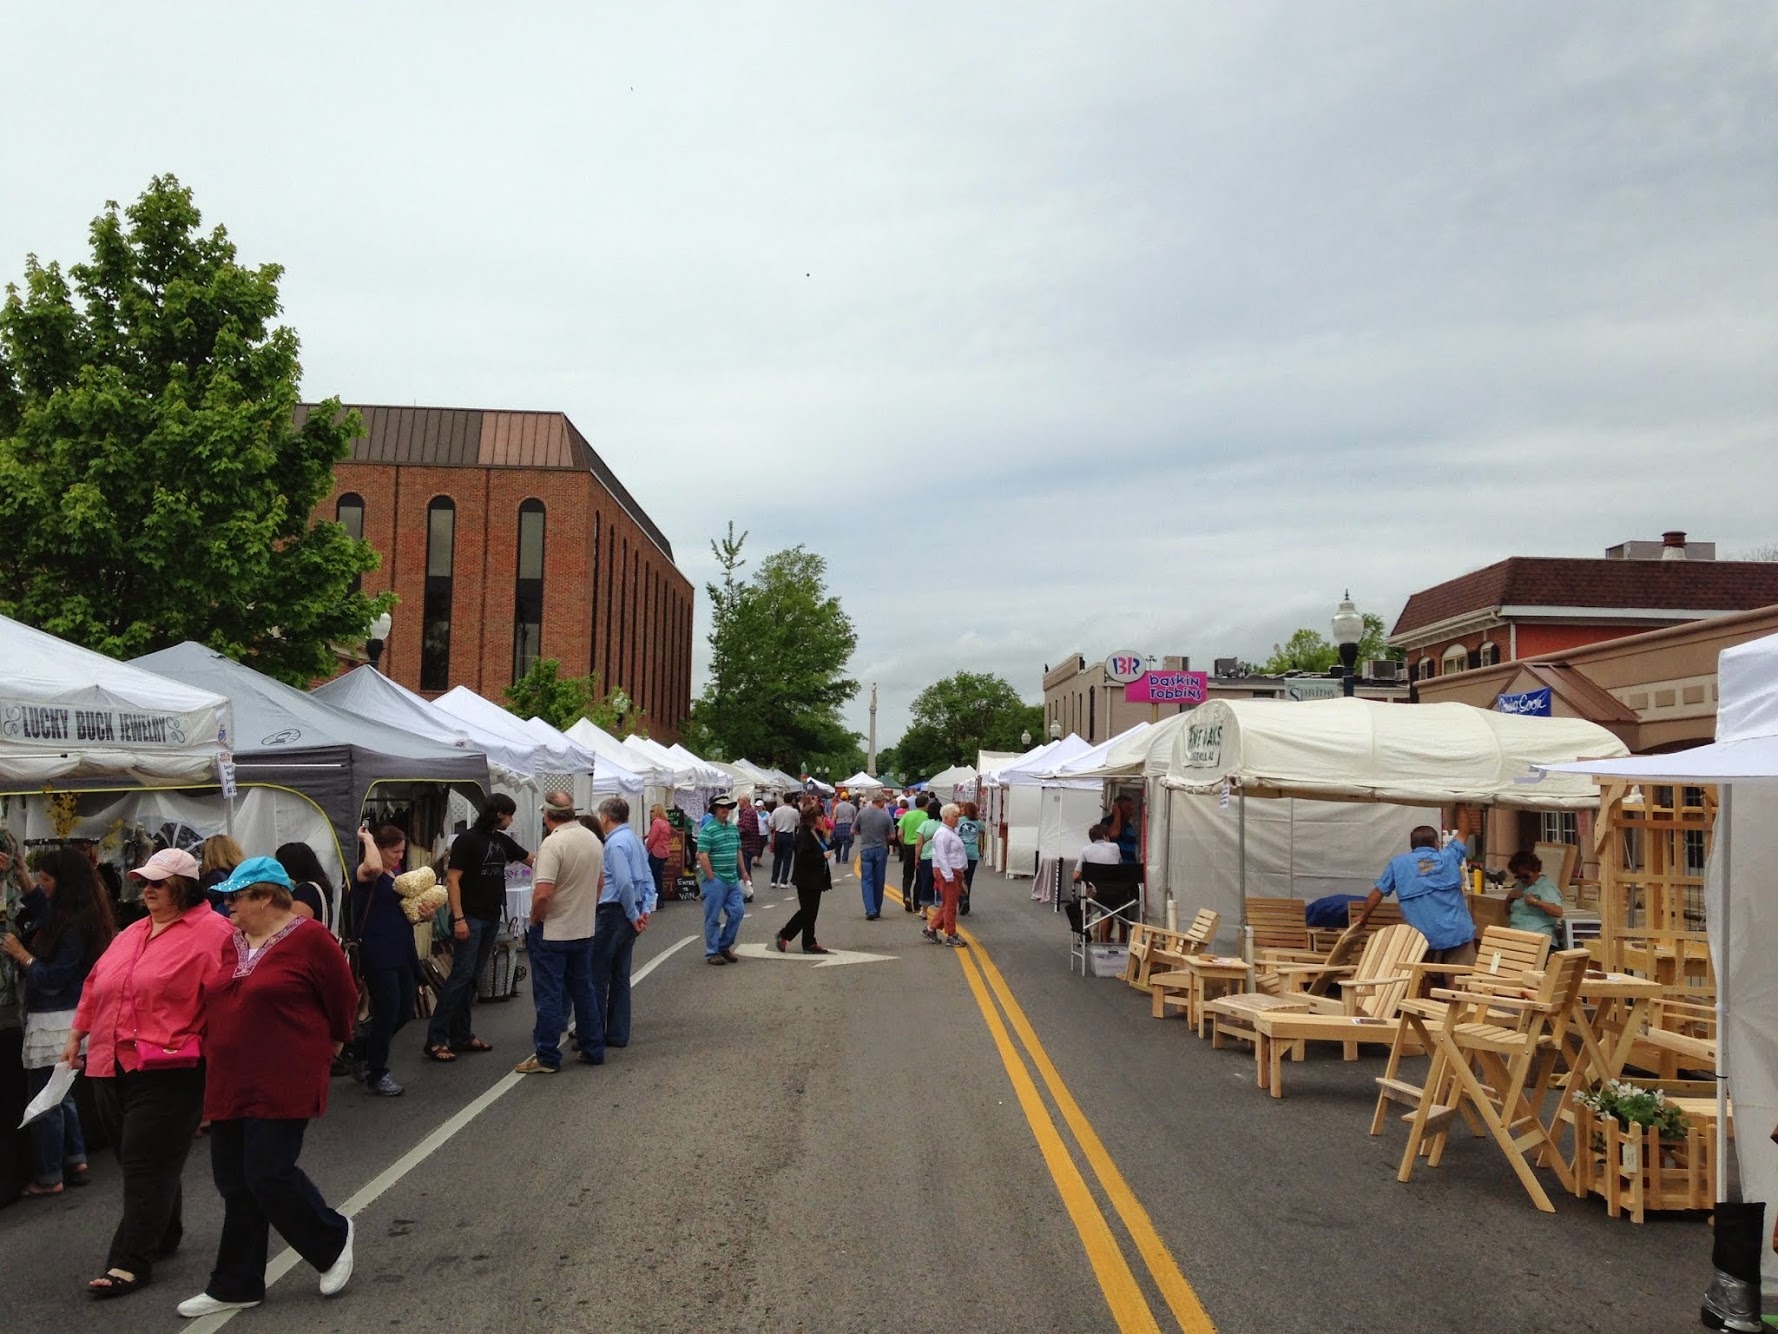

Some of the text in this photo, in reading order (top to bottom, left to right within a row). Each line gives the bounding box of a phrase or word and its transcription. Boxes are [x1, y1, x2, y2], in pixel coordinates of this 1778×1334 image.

[1112, 656, 1140, 675] BR
[1149, 673, 1200, 688] baskin
[1150, 686, 1202, 701] robbins
[22, 706, 167, 743] LUCKY BUCK JEWELRY
